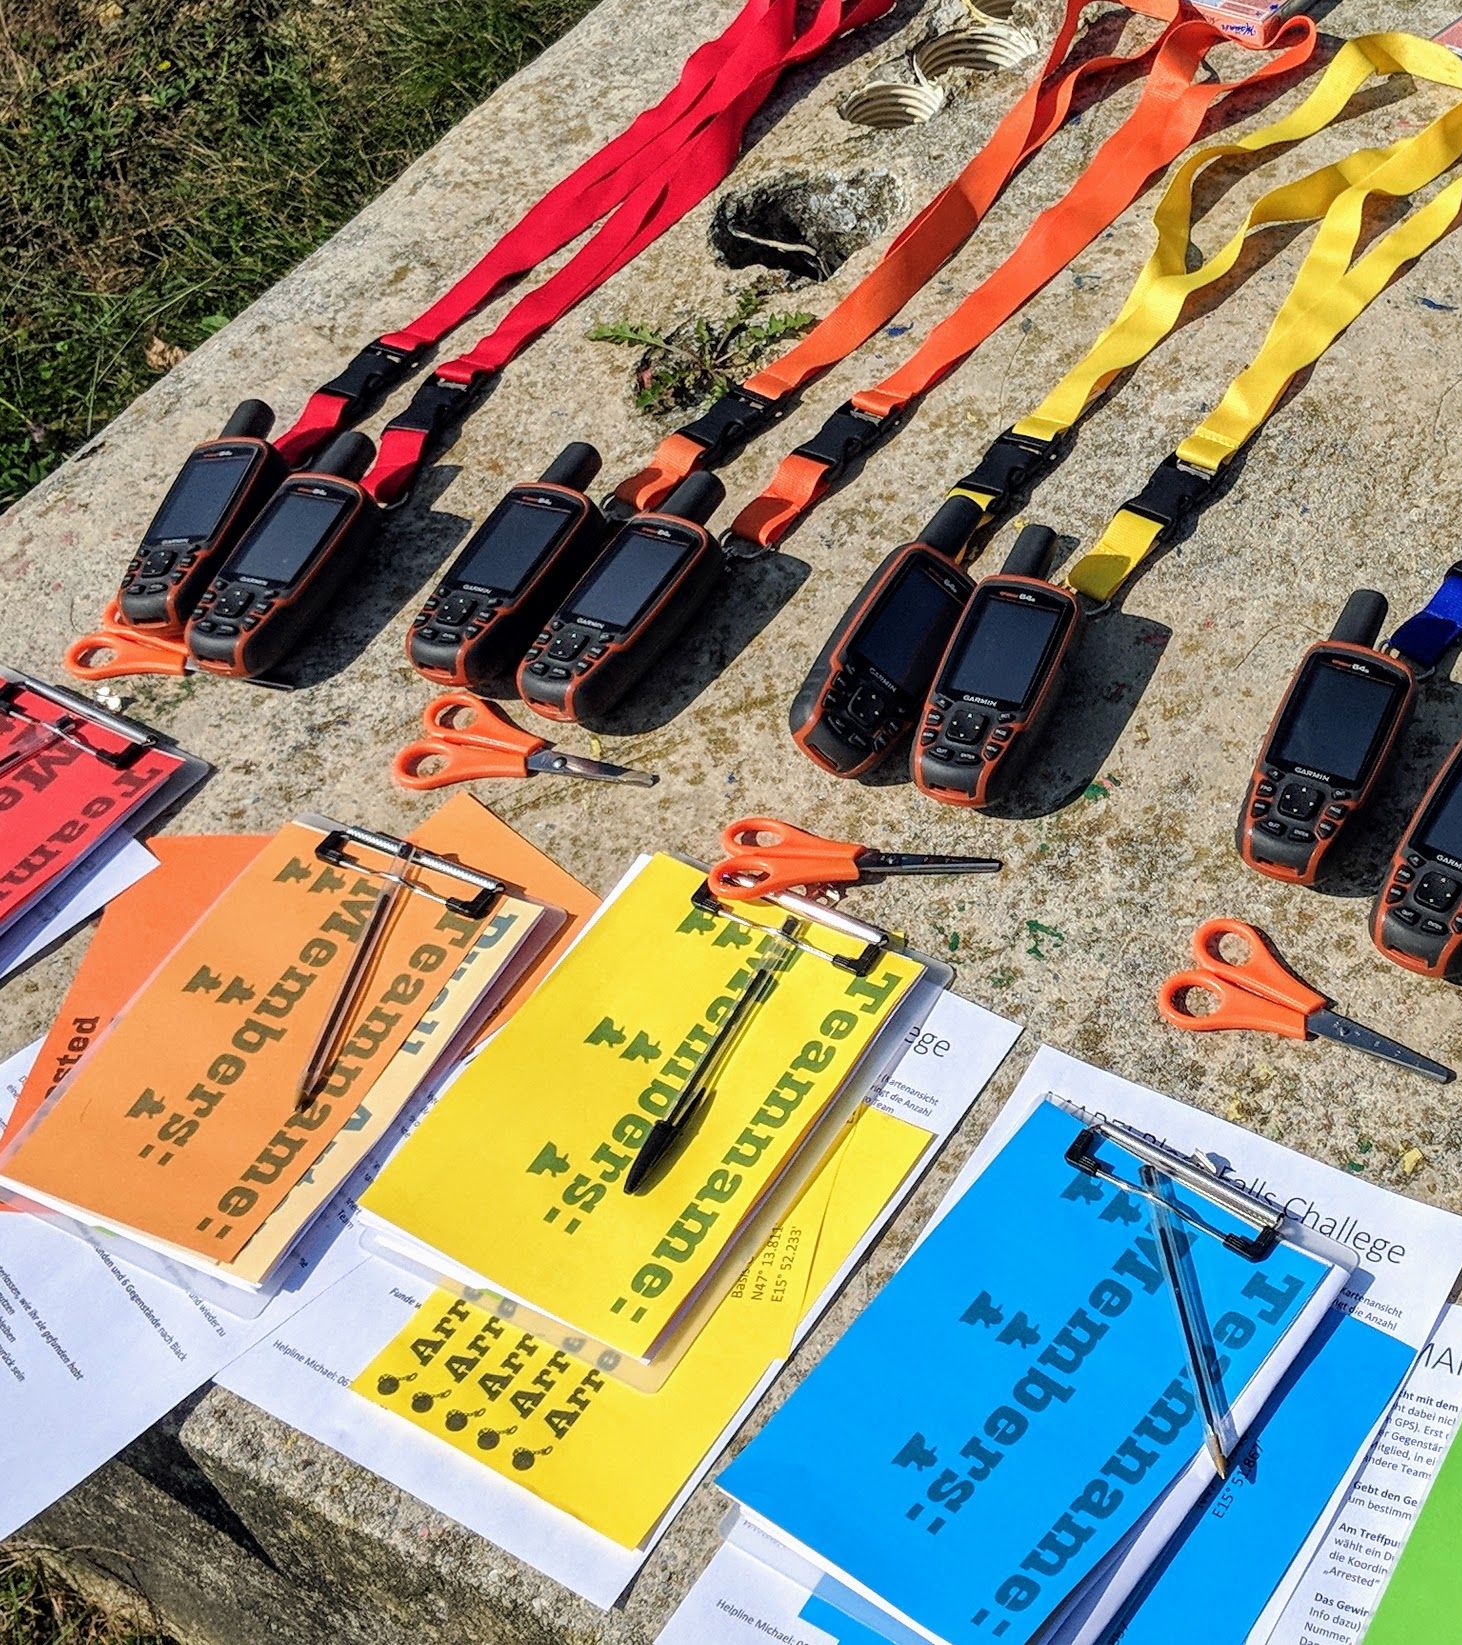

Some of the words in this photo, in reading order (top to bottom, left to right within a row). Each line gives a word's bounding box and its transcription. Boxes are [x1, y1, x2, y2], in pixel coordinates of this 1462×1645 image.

[962, 694, 998, 707] GARMIN
[1294, 766, 1331, 782] GARMIN
[137, 877, 384, 1167] Members:
[196, 904, 482, 1240] Teamname:
[544, 932, 803, 1236] Members:
[903, 1099, 933, 1118] Anzahl
[610, 971, 903, 1322] Teamname:
[1283, 1196, 1407, 1266] Challege
[770, 1273, 788, 1303] E15°
[780, 1226, 802, 1271] 52.233'
[389, 1287, 416, 1306] Funde
[110, 1265, 127, 1281] und
[125, 1284, 161, 1330] Gegenstände
[158, 1327, 175, 1345] nach
[169, 1341, 188, 1362] Black
[199, 1305, 221, 1329] wieder
[216, 1326, 227, 1338] zu
[1348, 1305, 1364, 1317] die
[1364, 1312, 1398, 1332] Anzahl
[40, 1329, 71, 1366] gefunden
[66, 1361, 86, 1382] habt
[272, 1338, 305, 1363] Helpline
[304, 1356, 339, 1382] Michael:
[905, 1216, 1197, 1536] Members:
[1407, 1405, 1437, 1421] dabei
[1415, 1394, 1434, 1407] mit
[1435, 1398, 1459, 1413] dem
[1423, 1425, 1444, 1439] Erst
[1413, 1451, 1424, 1463] in
[1211, 1486, 1234, 1519] E15°
[1353, 1480, 1380, 1495] Gebt
[1381, 1488, 1401, 1503] den
[1338, 1522, 1358, 1536] Am
[1329, 1549, 1346, 1563] die
[1334, 1537, 1364, 1553] wählt
[1365, 1545, 1382, 1559] ein
[715, 1599, 754, 1625] Helpline
[1314, 1591, 1334, 1607] Das
[1309, 1606, 1331, 1622] Info
[1332, 1614, 1362, 1633] dazu)
